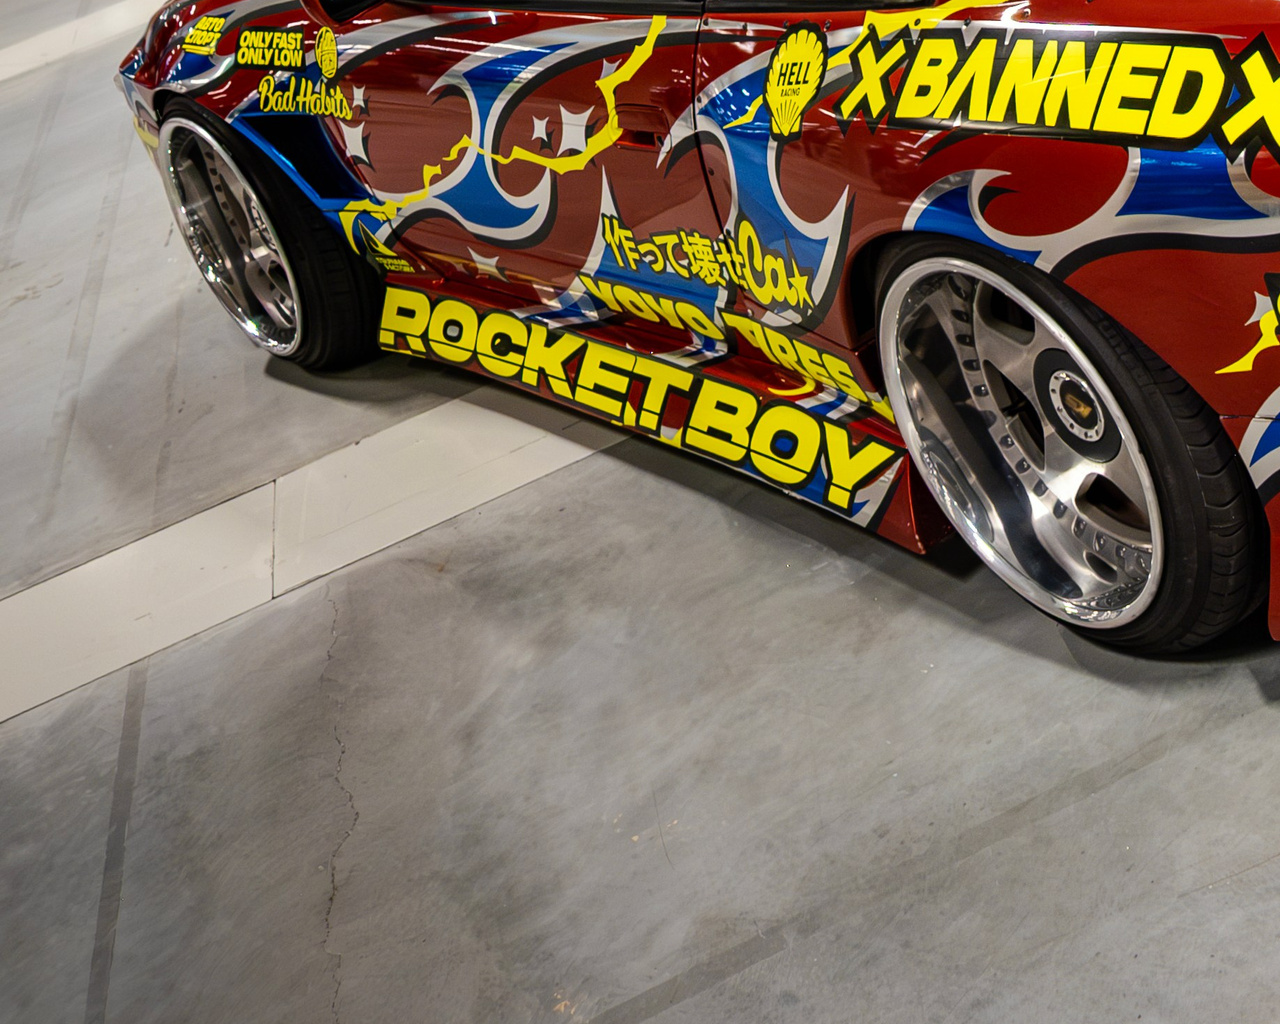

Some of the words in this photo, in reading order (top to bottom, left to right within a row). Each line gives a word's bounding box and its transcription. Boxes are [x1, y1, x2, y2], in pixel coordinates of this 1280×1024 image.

[195, 16, 226, 32] АВТО
[239, 31, 273, 48] ONLY
[272, 32, 303, 50] FAST
[237, 47, 274, 65] ONLY
[274, 49, 303, 67] LOW
[777, 61, 810, 86] HELL
[258, 75, 296, 112] Bad
[295, 77, 353, 121] Habits
[781, 87, 801, 97] RACING
